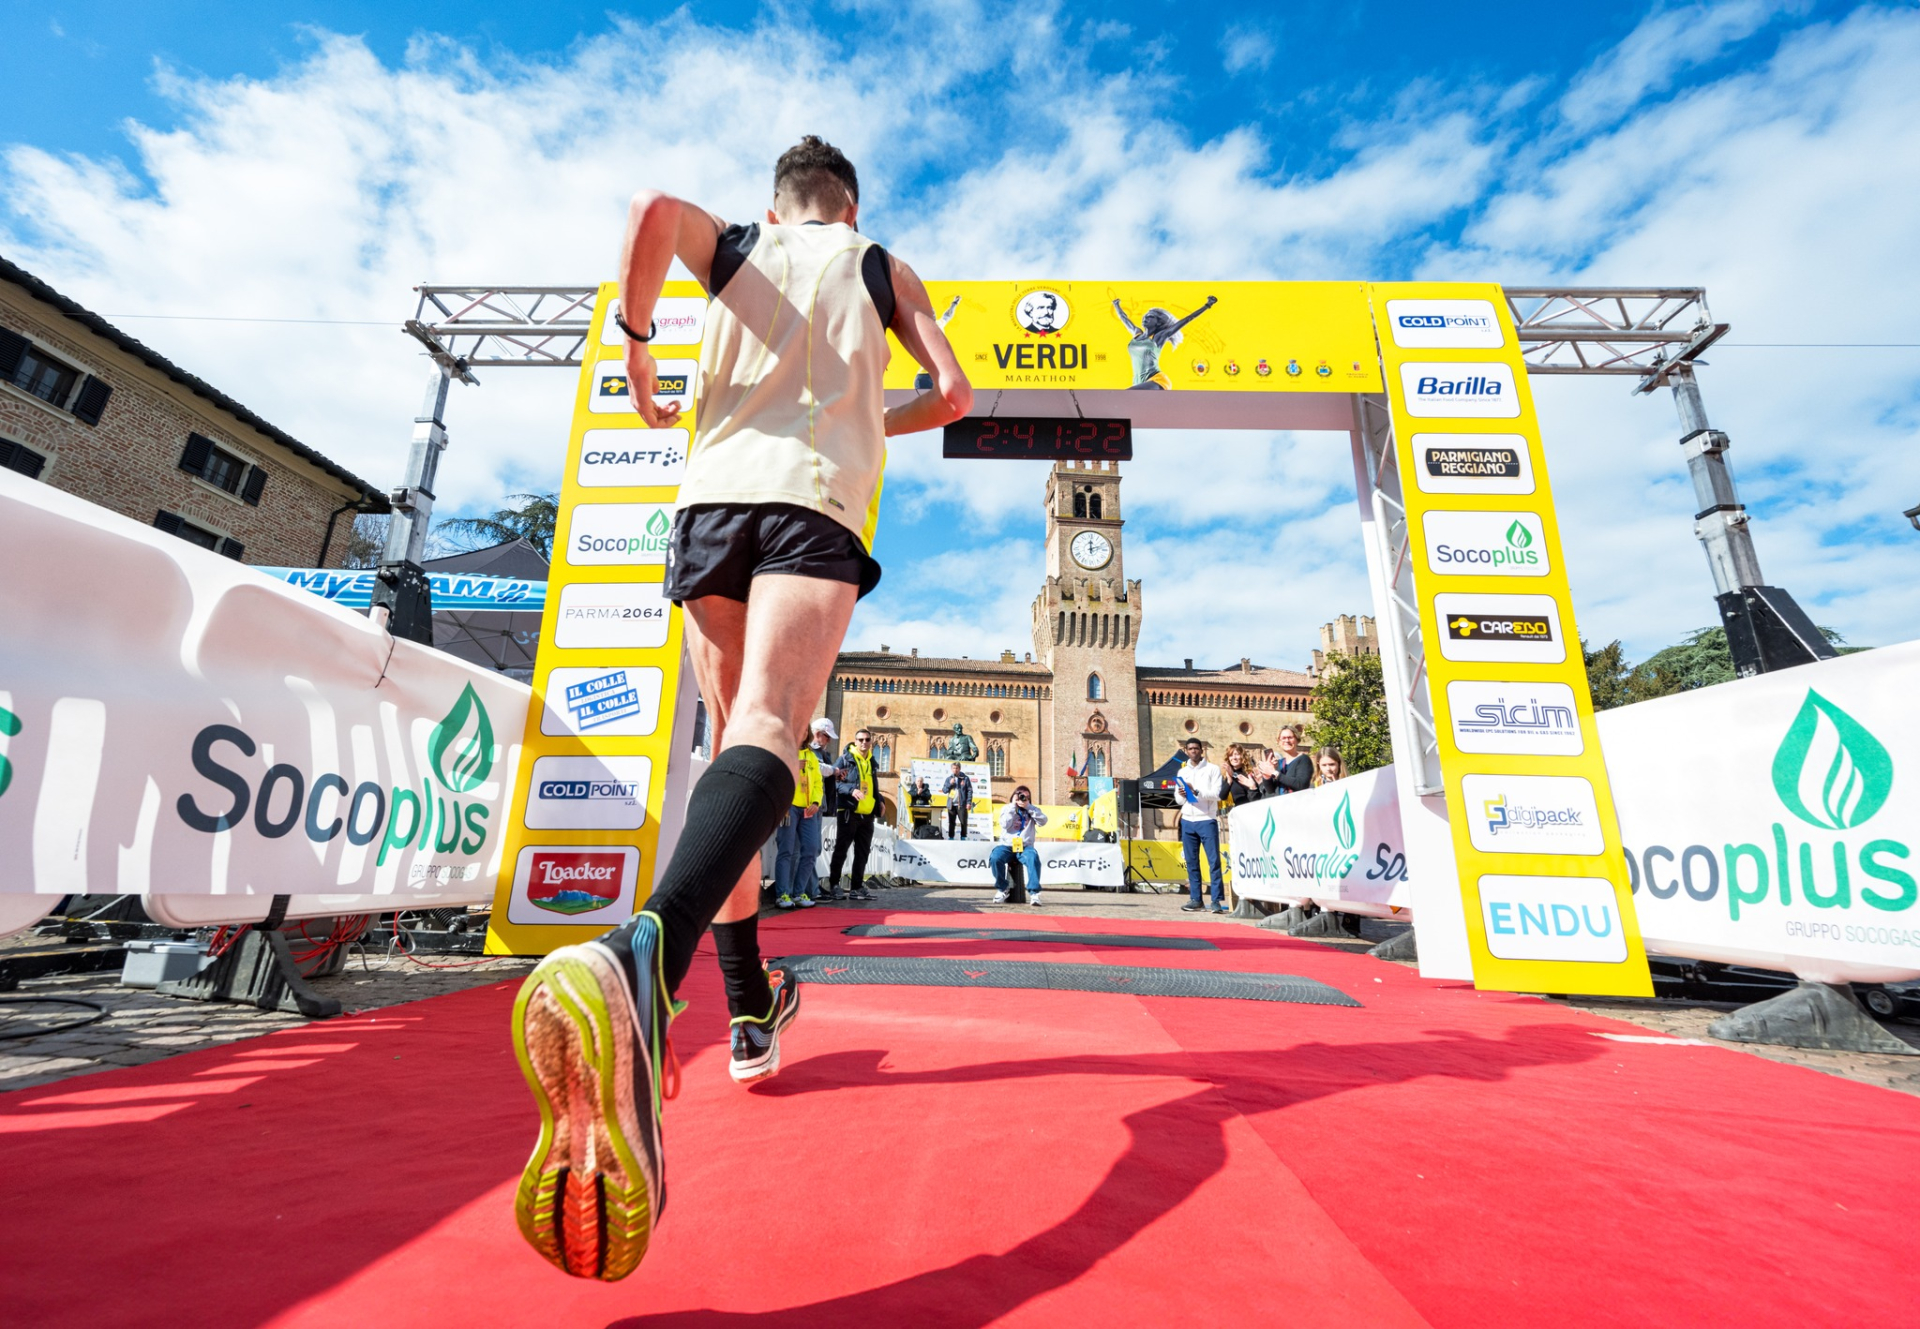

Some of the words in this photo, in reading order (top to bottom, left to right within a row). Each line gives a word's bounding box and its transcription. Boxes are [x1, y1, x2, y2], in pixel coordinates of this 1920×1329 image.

[1402, 317, 1443, 326] COLD
[992, 344, 1088, 370] VERDI
[1005, 374, 1077, 382] MARATHON
[1417, 376, 1502, 395] Barilla
[584, 451, 662, 464] CRAFT
[1431, 451, 1512, 462] PARMIGIANO
[1441, 462, 1506, 474] REGGIANO
[577, 534, 669, 555] Socoplus
[1436, 544, 1539, 568] Socoplus
[1480, 621, 1547, 634] CAREBO
[569, 686, 583, 698] IL
[586, 673, 625, 693] COLLE
[580, 706, 594, 717] IL
[598, 692, 636, 712] COLLE
[176, 723, 489, 868] Socoplus
[543, 784, 587, 796] COLD
[1507, 806, 1581, 827] digipack
[411, 864, 442, 878] GRUPPO
[538, 861, 616, 884] Loacker
[957, 859, 991, 868] CRA
[1047, 860, 1096, 869] CRAFT
[1238, 852, 1279, 884] Socoplus
[1284, 846, 1359, 887] Socoplus
[1489, 901, 1612, 938] ENDU
[1786, 920, 1841, 941] GRUPPO
[1844, 924, 1920, 949] SOCOGAS
